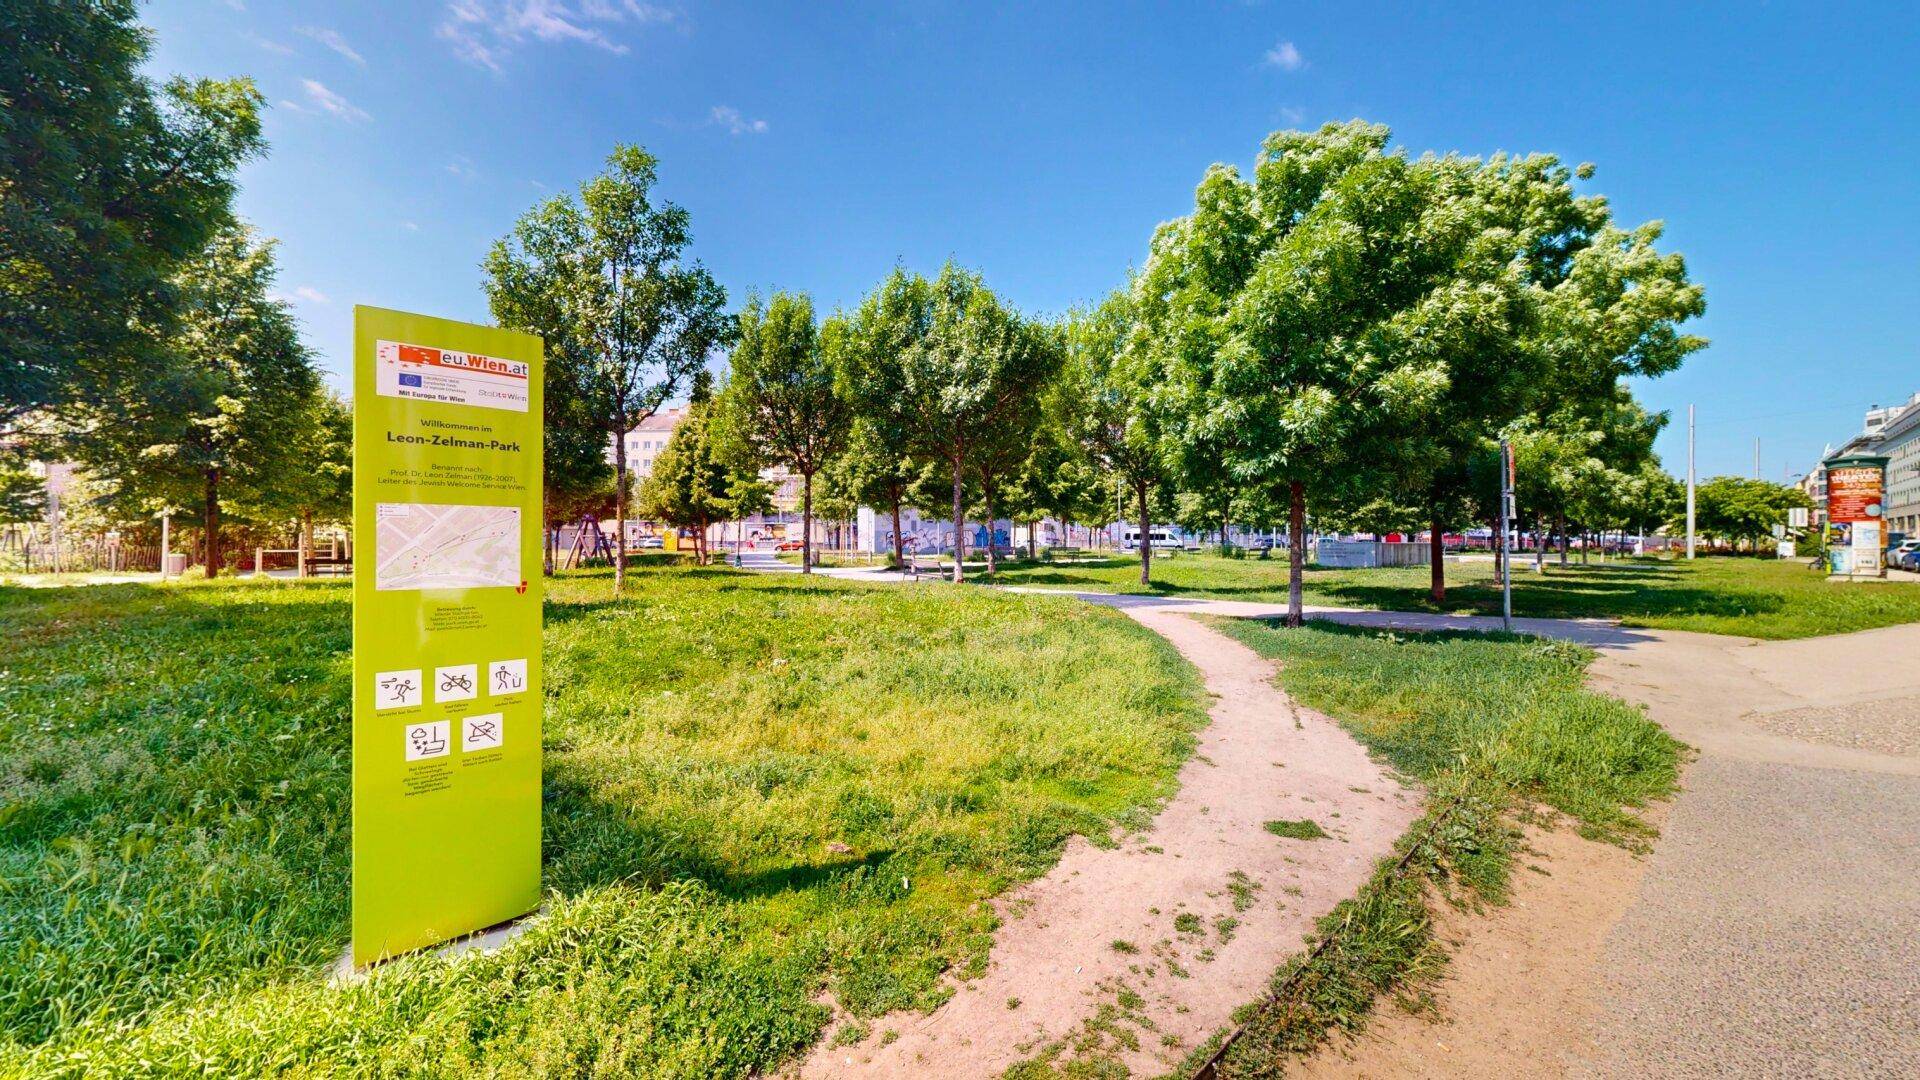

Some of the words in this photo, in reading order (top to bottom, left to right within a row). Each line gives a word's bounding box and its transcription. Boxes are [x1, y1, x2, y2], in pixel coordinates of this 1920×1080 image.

[442, 353, 527, 375] eu.Wien.at
[412, 392, 436, 400] Europa
[420, 419, 479, 432] Willkommen
[481, 425, 492, 433] im
[387, 431, 520, 452] Leon-Zelman-Park
[431, 463, 464, 472] Benannt
[390, 469, 408, 477] Prof.
[411, 470, 423, 478] Dr.
[424, 471, 444, 479] Leon
[445, 472, 473, 480] Zelman
[377, 477, 401, 485] Leiter
[418, 479, 446, 487] Jewish
[446, 480, 481, 489] Welcome
